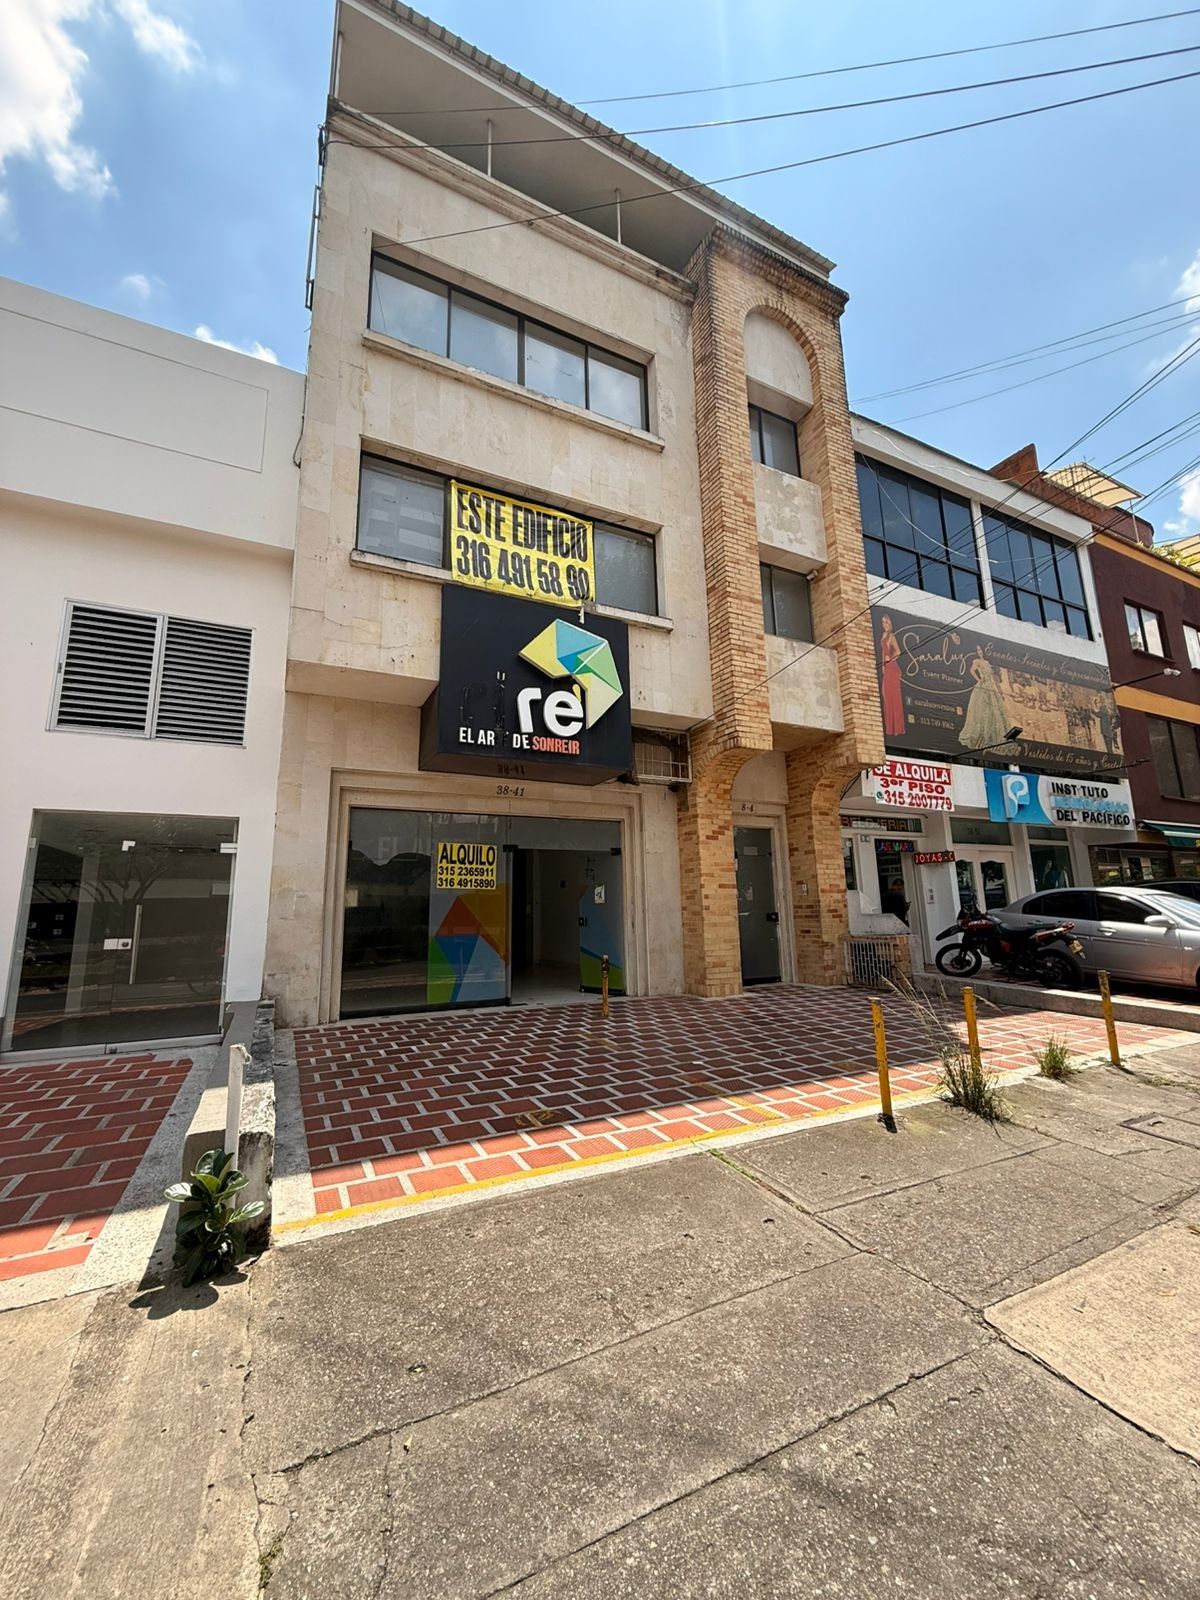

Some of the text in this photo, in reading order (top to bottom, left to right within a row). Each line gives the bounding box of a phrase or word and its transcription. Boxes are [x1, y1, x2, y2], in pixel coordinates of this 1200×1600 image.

[457, 488, 587, 562] ESTE EDIFICIO
[457, 535, 590, 601] 316 491 58 90
[459, 727, 474, 743] EL
[512, 733, 530, 749] DE
[532, 736, 580, 755] SONREIR
[1055, 751, 1064, 761] de
[1066, 753, 1073, 763] 15
[874, 761, 949, 783] SE ALQUILA
[496, 785, 525, 797] 38-41
[908, 781, 945, 794] PISO
[1052, 782, 1108, 798] INSTTUTO
[884, 790, 952, 810] 315 2007779
[841, 816, 908, 830] REOERIA
[1056, 810, 1130, 825] DEL PACÍFICO
[439, 844, 496, 866] ALQUILO
[438, 866, 494, 877] 315 2365911
[438, 878, 495, 888] 316 4915890
